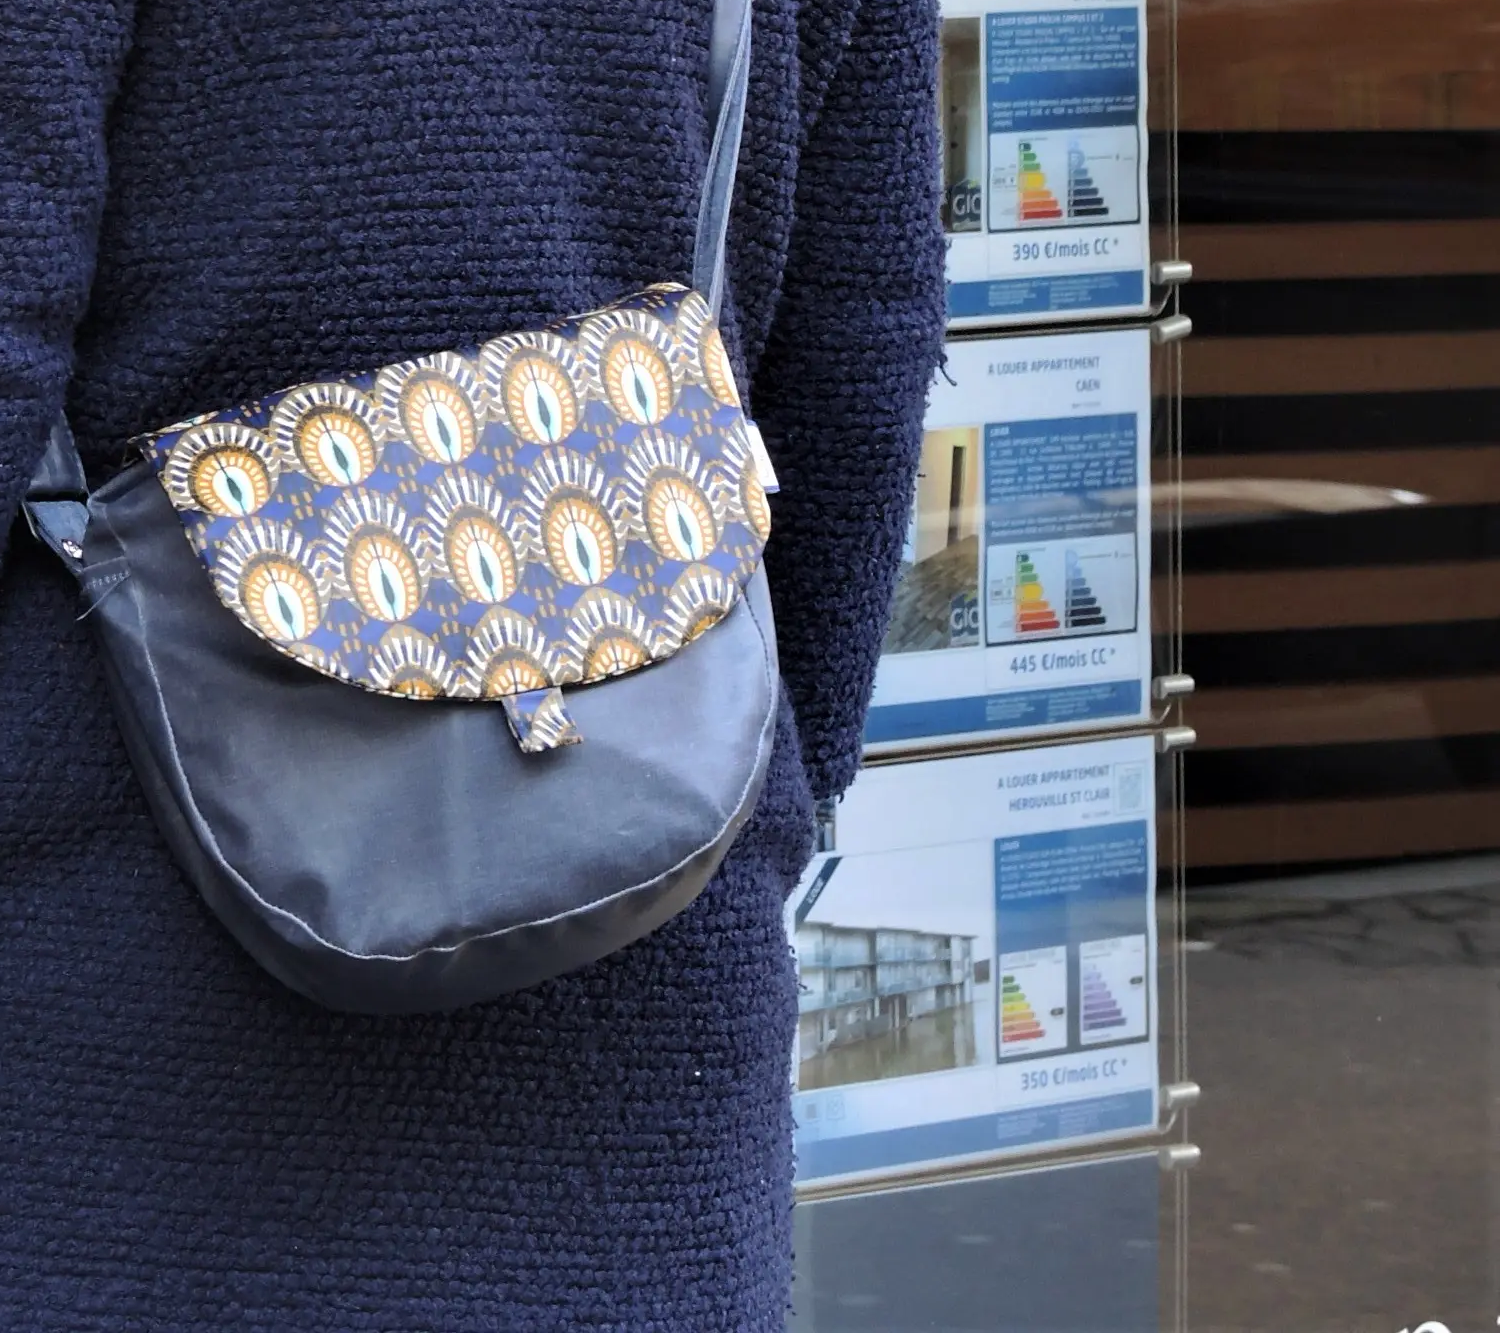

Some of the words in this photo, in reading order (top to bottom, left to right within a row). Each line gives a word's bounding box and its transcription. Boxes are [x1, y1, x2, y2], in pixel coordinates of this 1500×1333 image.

[1013, 243, 1040, 261] 390
[1044, 238, 1090, 259] €/mois
[1094, 238, 1110, 256] CC
[1010, 653, 1036, 675] 445
[1042, 649, 1088, 671] €/mois
[1090, 647, 1107, 665] CC
[1021, 1069, 1048, 1091] 350
[1052, 1062, 1098, 1087] €/mois
[1102, 1058, 1118, 1077] CC
